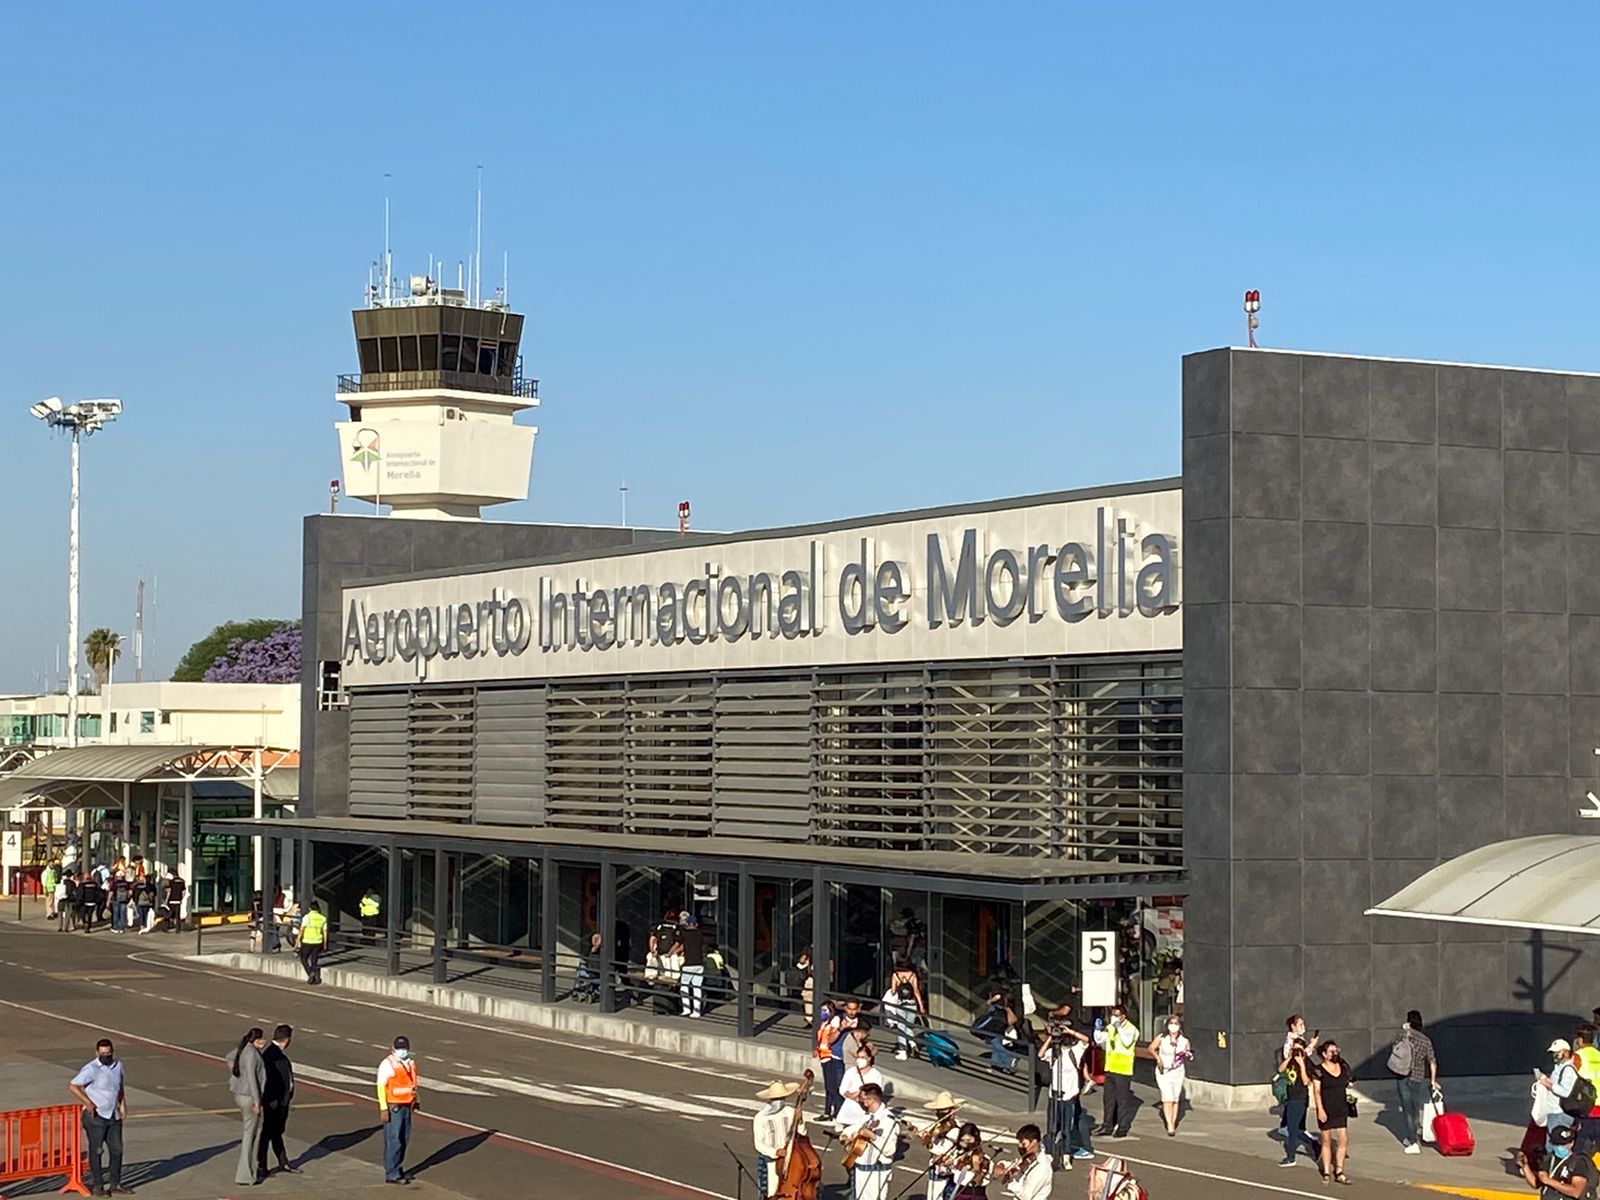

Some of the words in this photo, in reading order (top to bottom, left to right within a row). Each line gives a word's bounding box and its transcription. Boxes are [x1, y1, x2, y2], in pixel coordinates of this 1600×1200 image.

[387, 471, 421, 479] Morelia
[341, 587, 531, 682] Aeropuerto
[539, 539, 825, 652] Internacional
[839, 537, 911, 635] de
[927, 507, 1180, 630] Morelia
[7, 834, 16, 847] 4
[1089, 937, 1107, 965] 5
